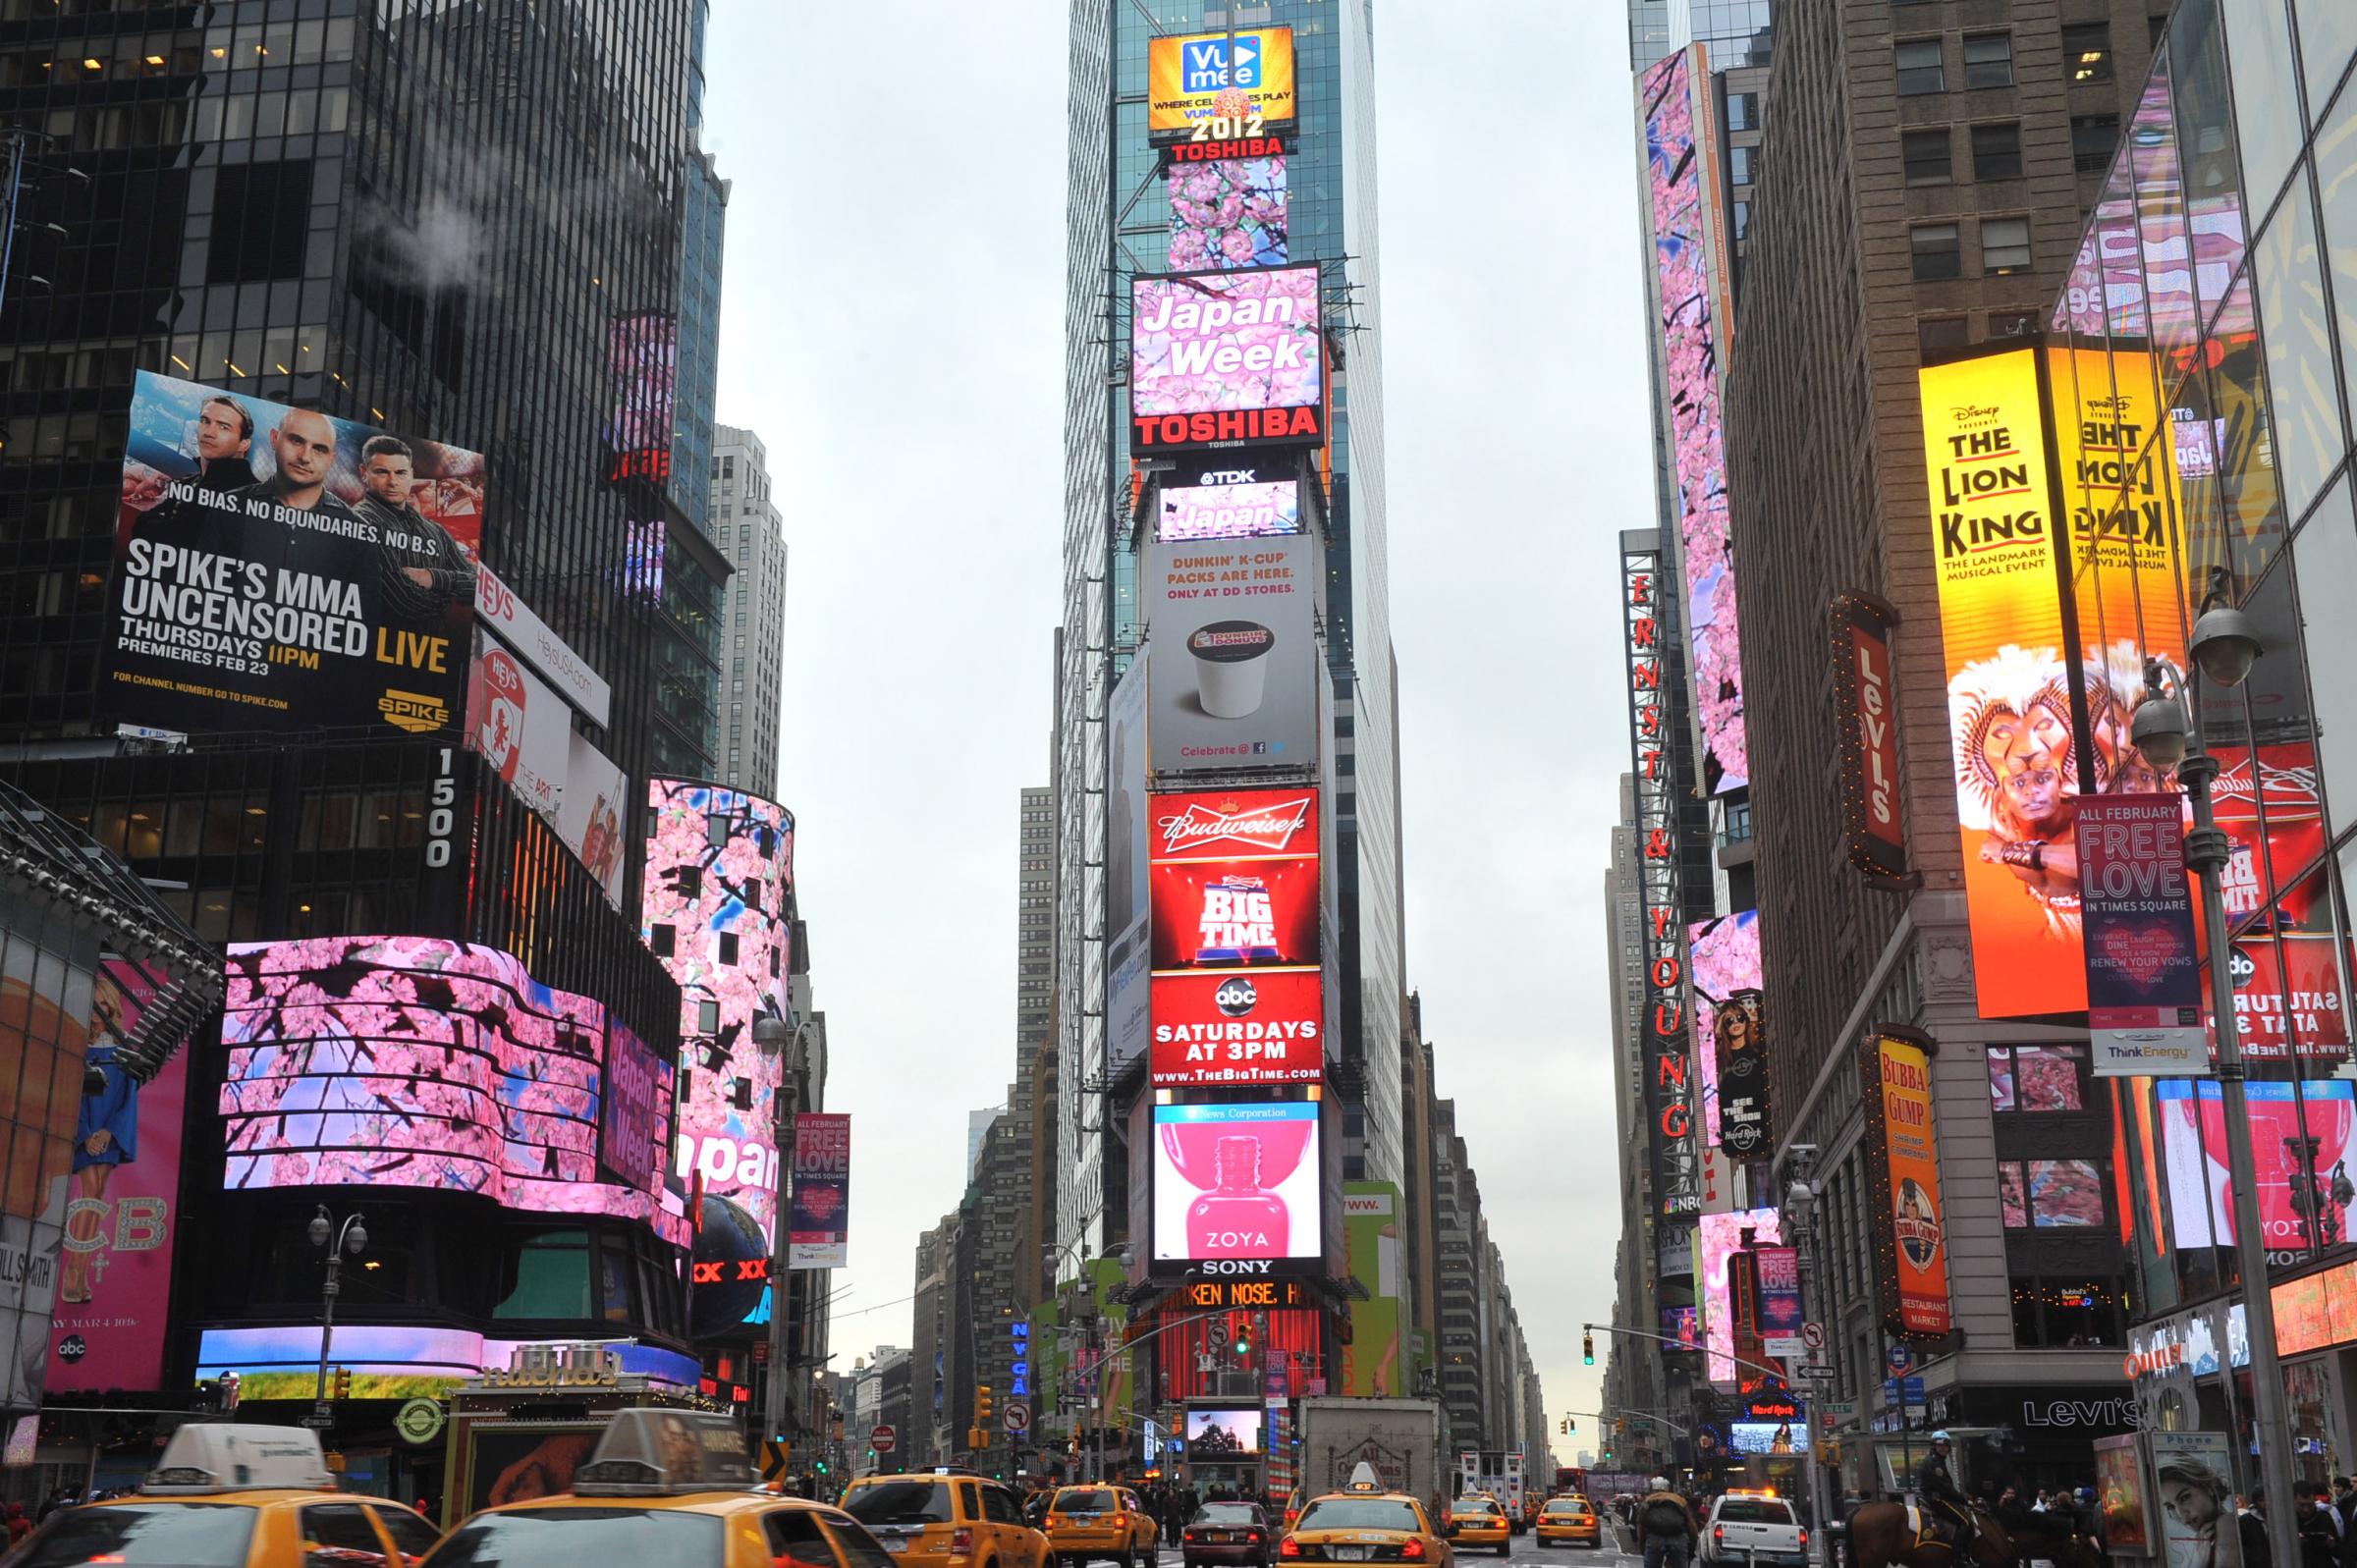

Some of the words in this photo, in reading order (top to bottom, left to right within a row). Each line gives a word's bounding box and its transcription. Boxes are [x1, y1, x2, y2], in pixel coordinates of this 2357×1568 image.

[1154, 99, 1193, 110] WHERE
[1263, 91, 1291, 102] PLAY
[1191, 115, 1264, 141] 2012
[1172, 137, 1284, 162] TOSHIBA
[1142, 296, 1293, 336] Japan
[1170, 335, 1305, 376] Week
[1949, 405, 2001, 421] Disney
[1134, 406, 1318, 446] TOSHIBA
[1958, 419, 1999, 430] PRESENTS
[1208, 440, 1244, 449] TOSHIBA
[1947, 426, 2011, 458] THE
[1214, 469, 1256, 484] TDK
[1942, 463, 2028, 507] LION
[169, 481, 193, 503] NO
[197, 488, 241, 514] BIAS.
[246, 499, 270, 519] NO
[274, 505, 381, 544] BOUNDARIES.
[385, 529, 407, 549] NO
[411, 536, 440, 557] B.S.
[1177, 504, 1274, 534] Japan
[1940, 510, 2044, 559] KING
[1173, 556, 1234, 569] DUNKIN'
[1239, 552, 1286, 567] K-CUP
[1944, 558, 1970, 571] THE
[1972, 548, 2047, 568] LANDMARK
[127, 538, 267, 599] SPIKE'S
[275, 568, 362, 620] MMA
[1168, 570, 1215, 584] PACKS
[1221, 569, 1248, 582] ARE
[1254, 568, 1294, 579] HERE.
[1946, 567, 2003, 582] MUSICAL
[2006, 559, 2047, 573] EVENT
[1168, 588, 1199, 600] ONLY
[1203, 587, 1219, 598] AT
[1223, 586, 1240, 597] DD
[1244, 584, 1295, 596] STORES.
[122, 575, 368, 657] UNCENSORED
[376, 626, 449, 675] LIVE
[120, 616, 262, 659] THURSDAYS
[268, 644, 319, 671] 11PM
[1215, 637, 1266, 646] DONUTS
[118, 636, 211, 665] PREMIERES
[216, 655, 246, 672] FEB
[248, 661, 269, 676] 23
[492, 656, 518, 690] HEYS
[113, 672, 132, 682] FOR
[133, 675, 174, 690] CHANNEL
[177, 682, 213, 698] NUMBER
[215, 689, 227, 699] GO
[229, 691, 240, 702] TO
[242, 694, 288, 710] SPIKE.COM
[378, 697, 449, 723] SPIKE
[1180, 744, 1235, 756] Celebrate
[426, 748, 455, 867] 1500
[2079, 807, 2103, 821] ALL
[2107, 806, 2177, 821] FEBRUARY
[1158, 814, 1305, 840] Budweiser
[2079, 823, 2181, 860] FREE
[1633, 575, 1661, 779] ERNST
[1650, 907, 1687, 1138] YOUNG
[2083, 861, 2185, 899] LOVE
[1204, 890, 1273, 924] BIG
[2086, 901, 2098, 912] IN
[2100, 900, 2137, 912] TIMES
[2140, 899, 2187, 912] SQUARE
[1198, 922, 1277, 947] TIME
[2107, 942, 2129, 950] DINE
[2090, 958, 2127, 968] RENEW
[2129, 957, 2159, 967] YOUR
[2161, 956, 2192, 966] VOWS
[1215, 986, 1257, 1005] abc
[1155, 1021, 1317, 1043] SATURDAYS
[1185, 1044, 1218, 1061] AT
[1227, 1042, 1287, 1060] 3PM
[2108, 1047, 2189, 1059] ThinkEnergy
[612, 1037, 652, 1109] Japan
[1882, 1053, 1927, 1092] BUBBA
[1723, 1107, 1743, 1115] THE
[1732, 1098, 1753, 1107] SEE
[1889, 1092, 1925, 1126] GUMP
[1201, 1109, 1226, 1119] News
[1229, 1108, 1287, 1120] Corporation
[1733, 1111, 1761, 1122] SHOW
[617, 1108, 653, 1176] Week
[796, 1129, 849, 1150] FREE
[1726, 1129, 1743, 1139] Hard
[1744, 1127, 1762, 1140] Rock
[1892, 1132, 1925, 1147] SHRIMP
[796, 1151, 848, 1171] LOVE
[1891, 1146, 1929, 1162] COMPANY
[1206, 1231, 1269, 1248] ZOYA
[1895, 1220, 1916, 1238] BUBBA
[1917, 1222, 1939, 1243] GUMP
[1203, 1260, 1273, 1275] SONY
[1760, 1260, 1796, 1274] FREE
[1761, 1274, 1798, 1289] LOVE
[1232, 1283, 1278, 1305] NOSE,
[1901, 1298, 1946, 1313] RESTAURANT
[1911, 1313, 1941, 1327] MARKET
[58, 1341, 86, 1355] abc
[480, 1357, 618, 1386] nuchas
[1752, 1404, 1774, 1415] Hard
[1774, 1404, 1794, 1417] Rock
[2167, 1435, 2212, 1444] Phone
